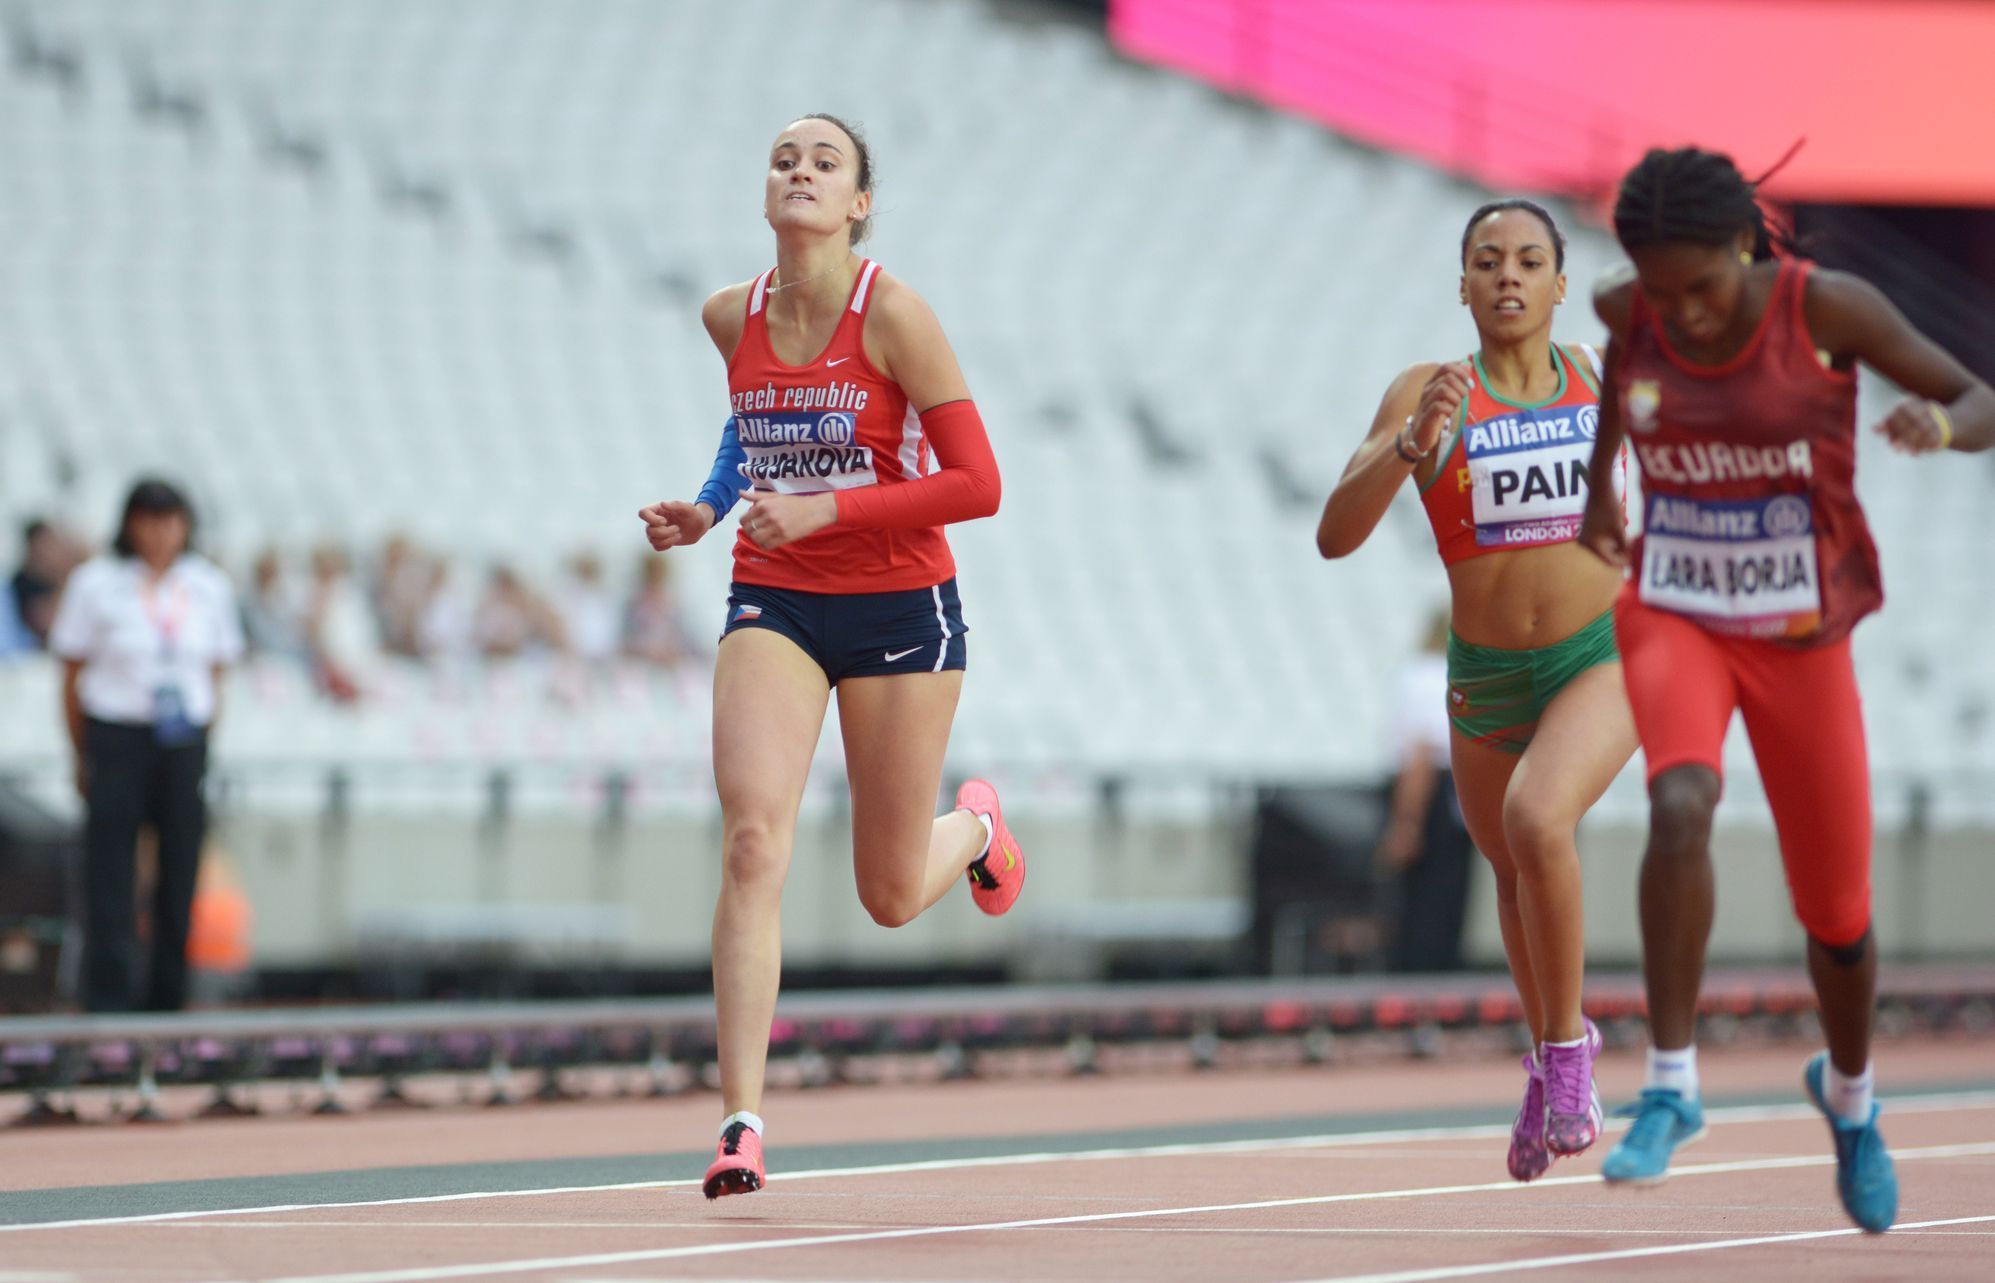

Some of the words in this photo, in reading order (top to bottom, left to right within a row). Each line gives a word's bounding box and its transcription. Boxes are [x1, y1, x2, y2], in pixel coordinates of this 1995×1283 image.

[731, 382, 776, 413] czech
[783, 381, 868, 412] republic
[737, 418, 814, 443] Allianz
[1469, 417, 1575, 452] Allianz
[1641, 439, 1813, 484] ECUADOR
[1650, 496, 1758, 537] Allianz
[1504, 526, 1573, 543] LONDON
[1651, 551, 1718, 595] LARA
